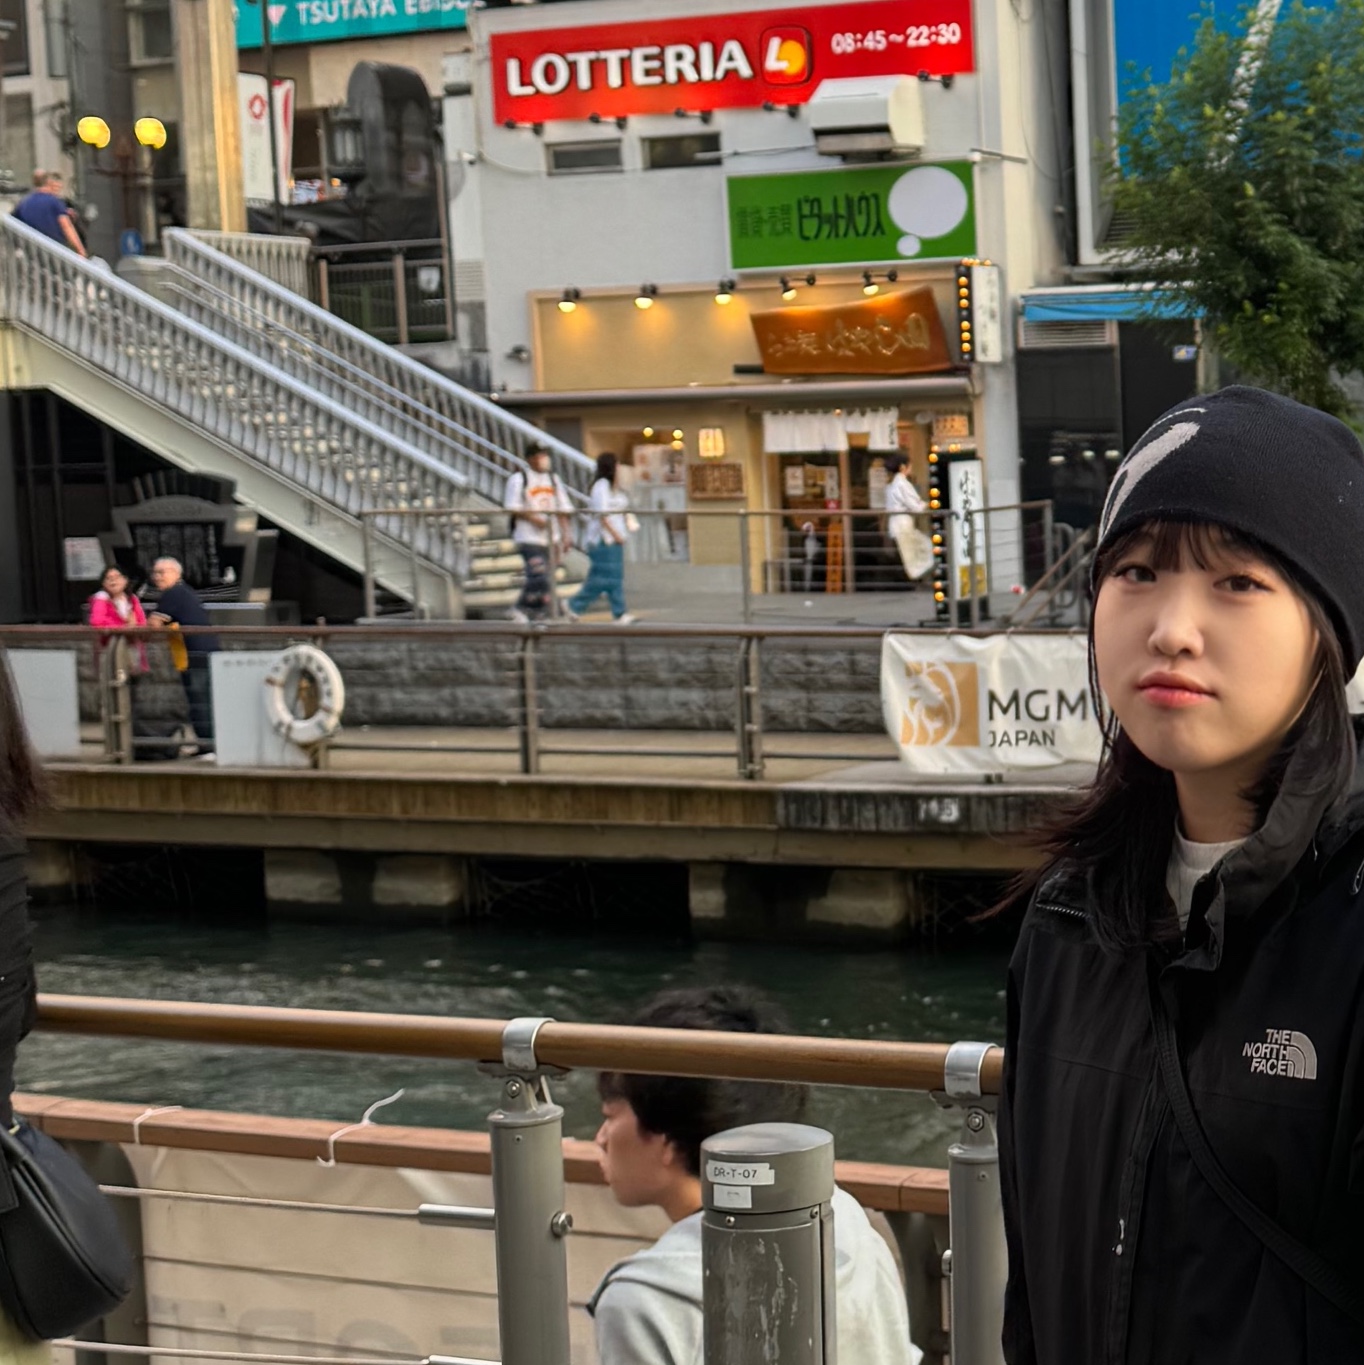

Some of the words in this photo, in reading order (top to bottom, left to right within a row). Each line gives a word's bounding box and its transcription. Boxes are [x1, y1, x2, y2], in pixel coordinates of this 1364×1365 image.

[296, 0, 397, 24] TSUTAYA
[505, 39, 753, 97] LOTTERIA
[987, 688, 1088, 722] MGM
[988, 729, 1056, 748] JAPAN
[1265, 1028, 1292, 1045] THE
[1242, 1042, 1290, 1060] NORTH
[1250, 1058, 1288, 1076] FACE
[713, 1165, 759, 1179] DR-T-07
